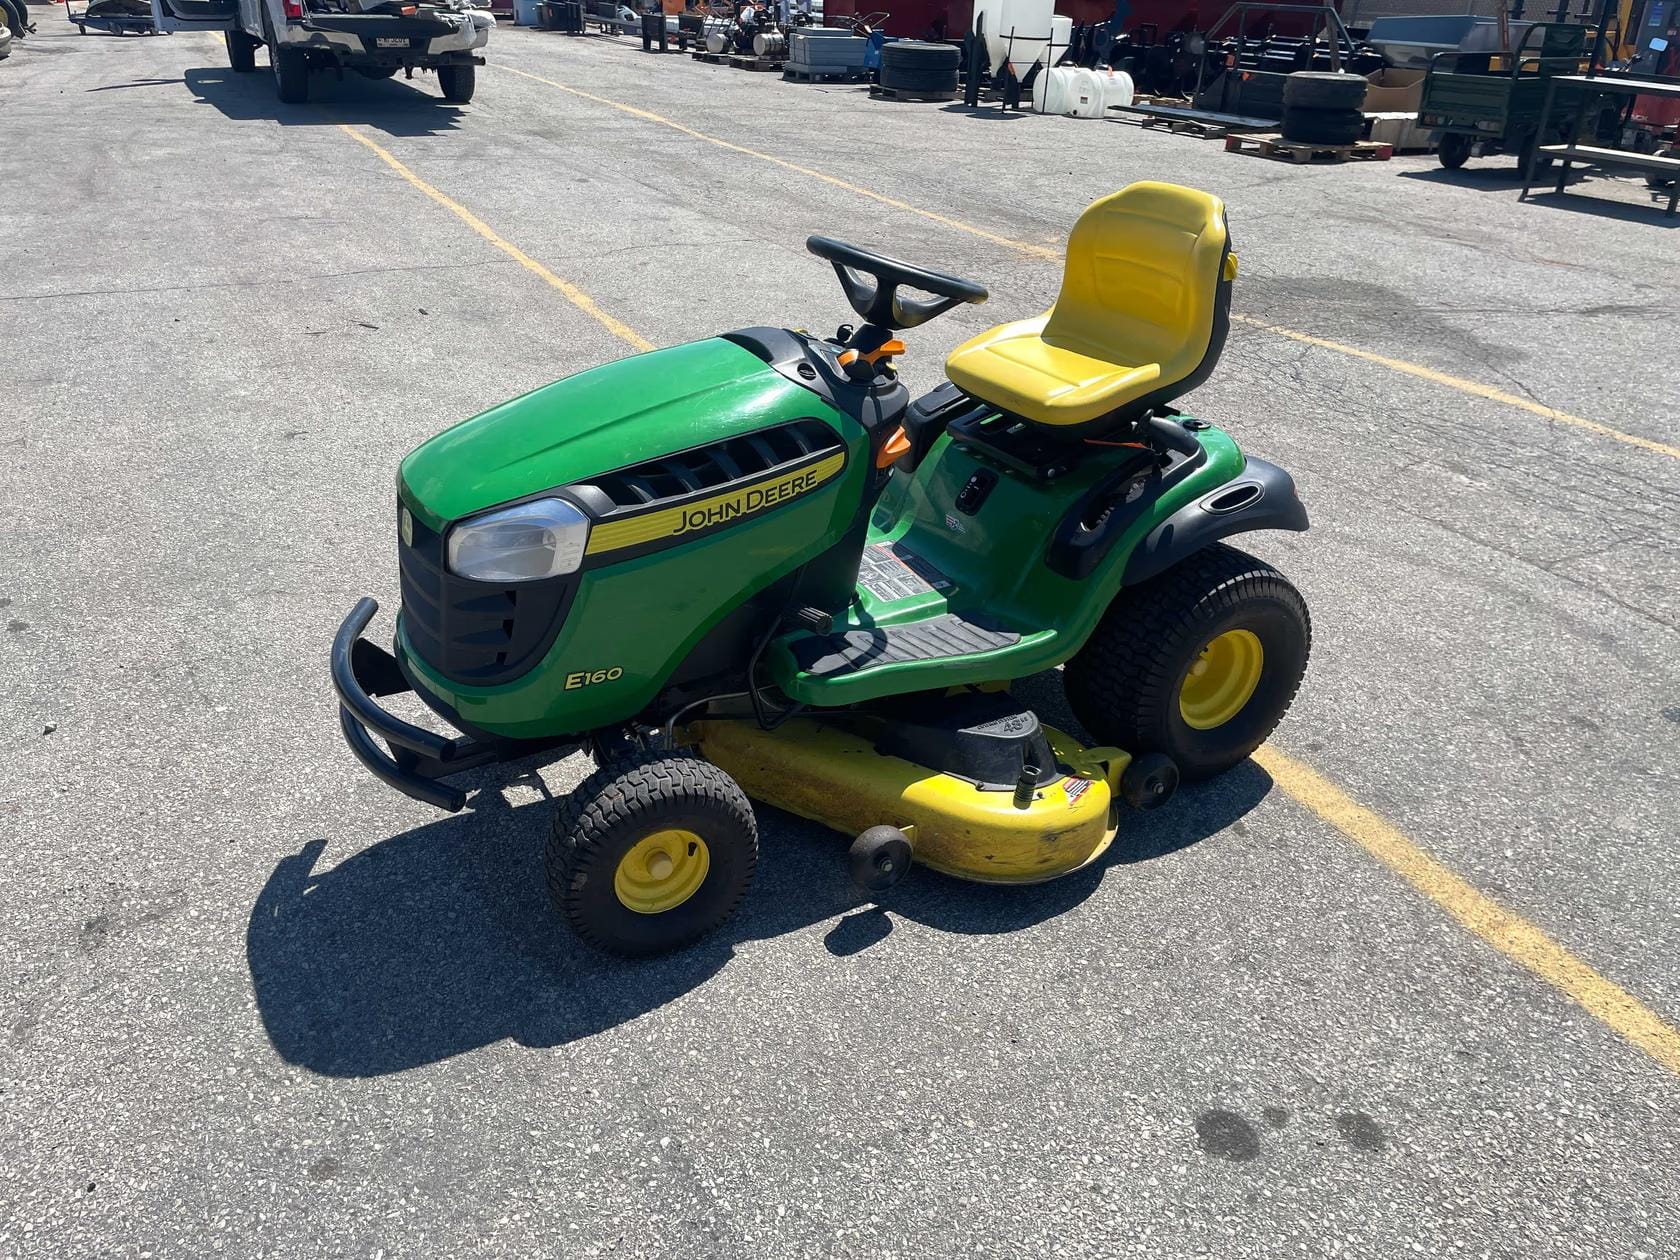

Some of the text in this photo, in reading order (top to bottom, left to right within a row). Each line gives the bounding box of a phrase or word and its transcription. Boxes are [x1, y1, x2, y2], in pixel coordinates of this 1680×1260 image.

[673, 469, 818, 534] JOHN DEERE
[564, 666, 624, 691] E160
